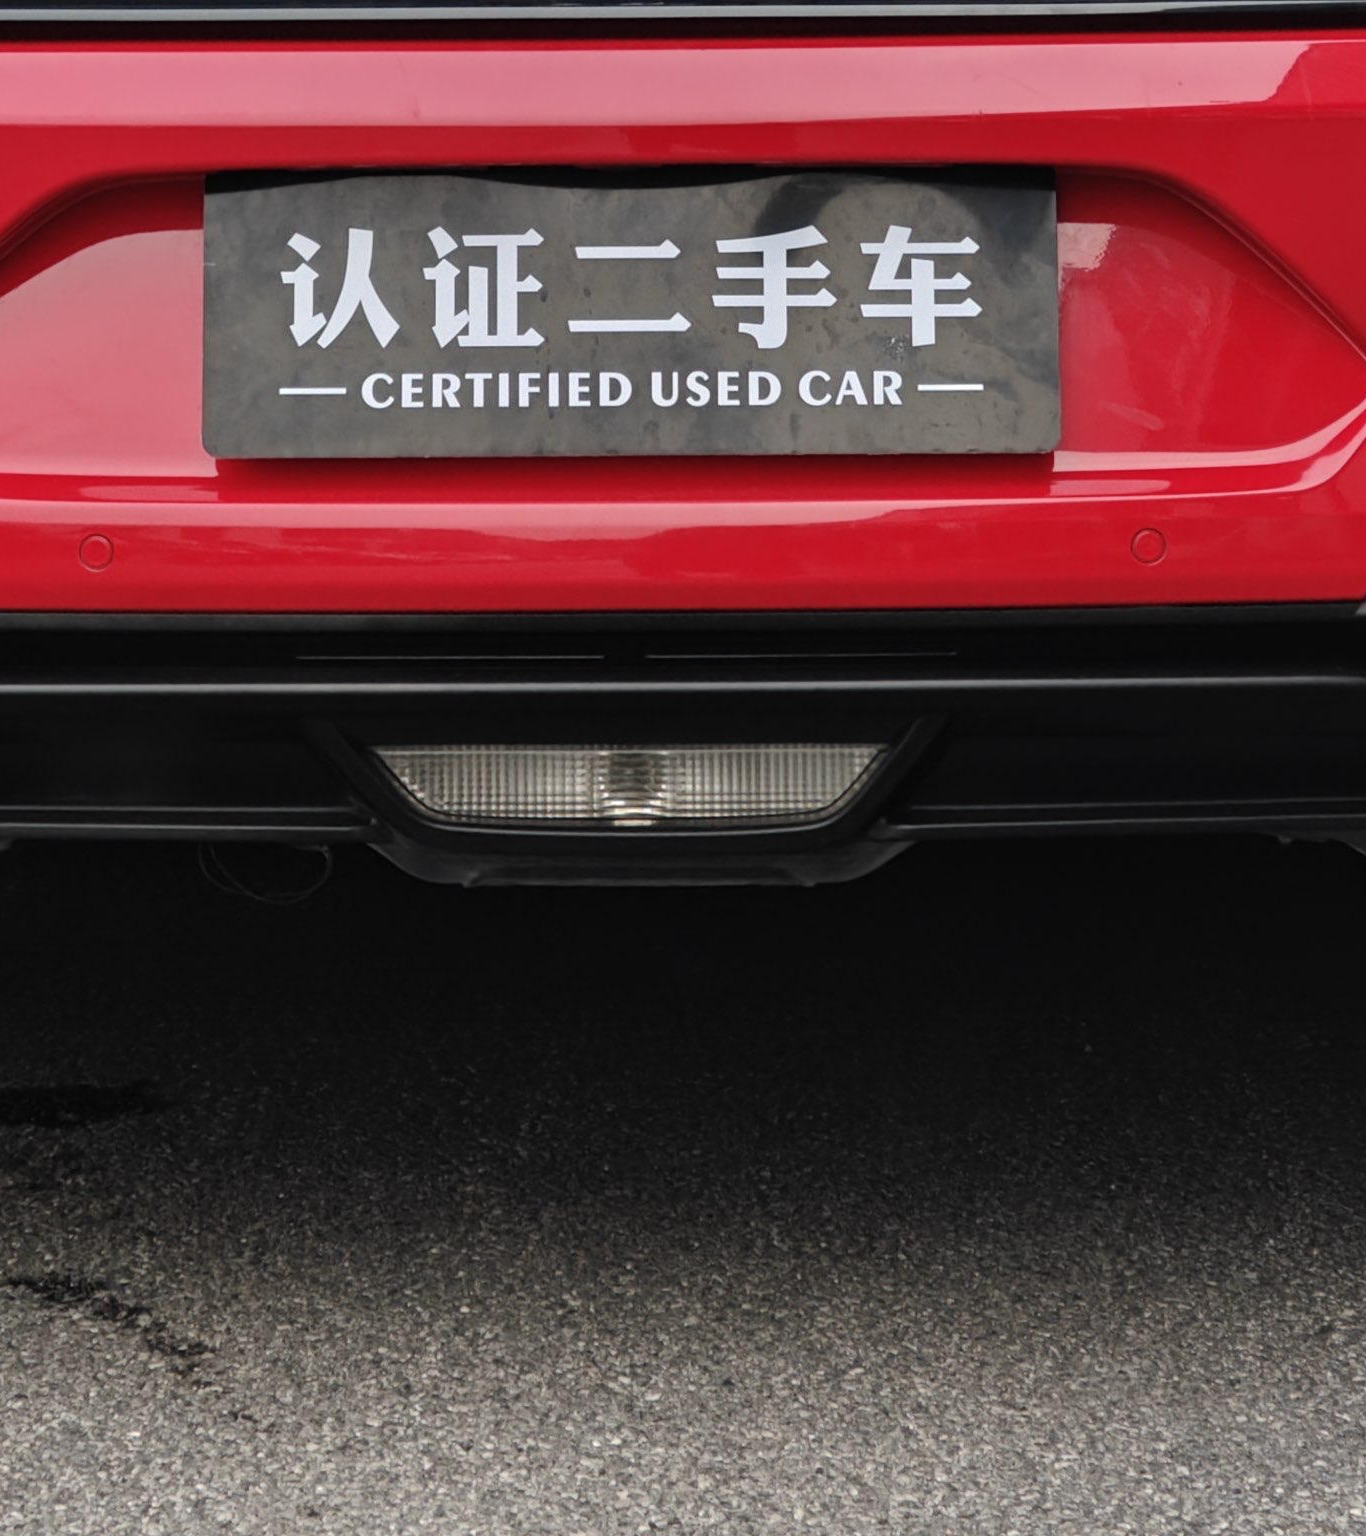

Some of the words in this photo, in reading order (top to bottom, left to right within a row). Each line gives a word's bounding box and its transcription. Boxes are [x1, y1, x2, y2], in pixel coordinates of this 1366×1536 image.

[280, 223, 984, 350] 认证二手车
[360, 371, 633, 410] CERTIFIED
[650, 370, 783, 408] USED
[798, 369, 903, 407] CAR
